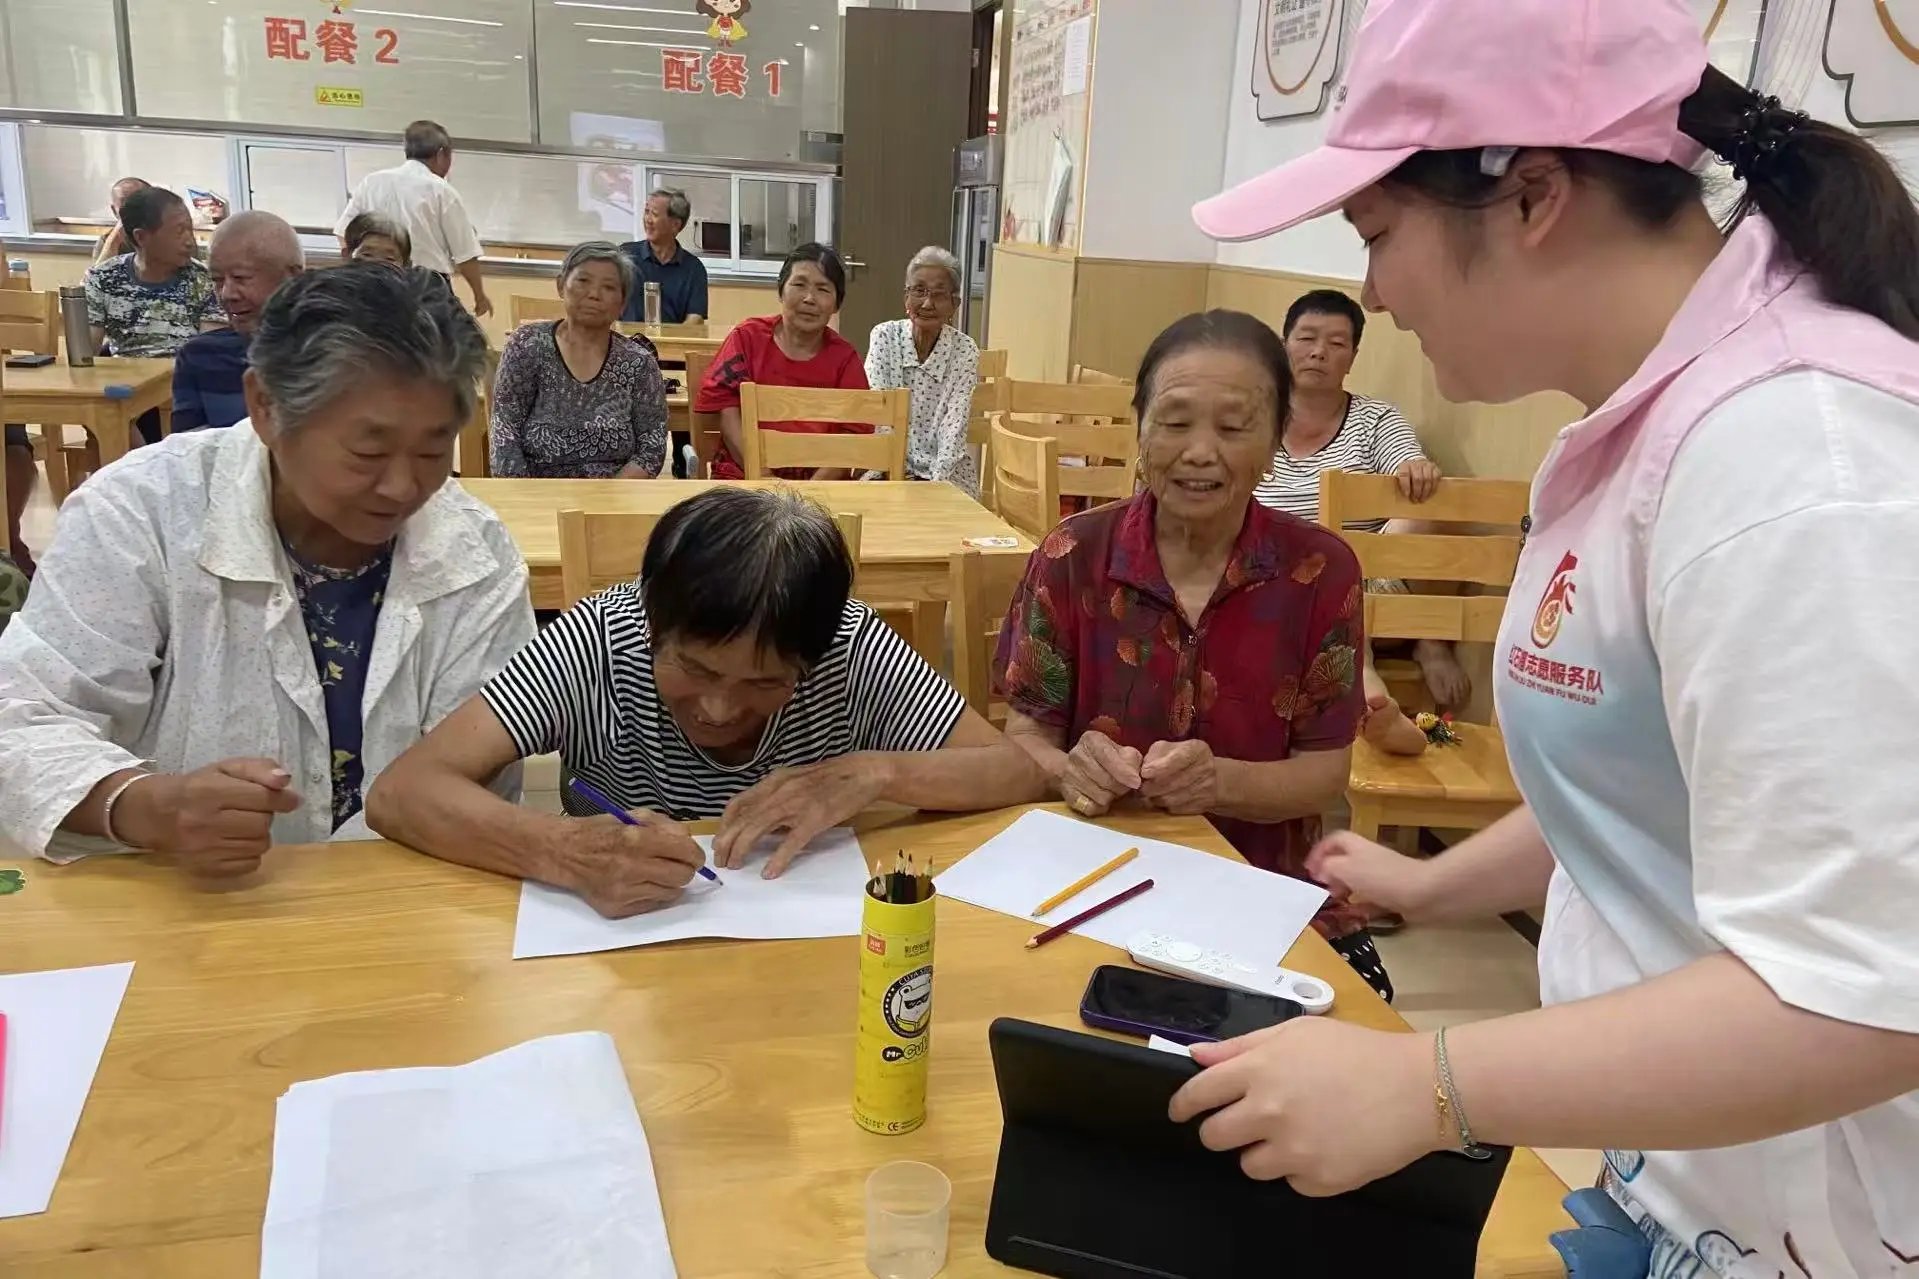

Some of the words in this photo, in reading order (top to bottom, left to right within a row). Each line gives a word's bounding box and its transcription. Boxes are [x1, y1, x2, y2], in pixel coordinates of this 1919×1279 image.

[264, 17, 358, 64] 配餐
[374, 28, 399, 64] 2
[661, 49, 749, 98] 配餐
[763, 60, 780, 97] 1
[1509, 645, 1603, 695] 志愿服务队
